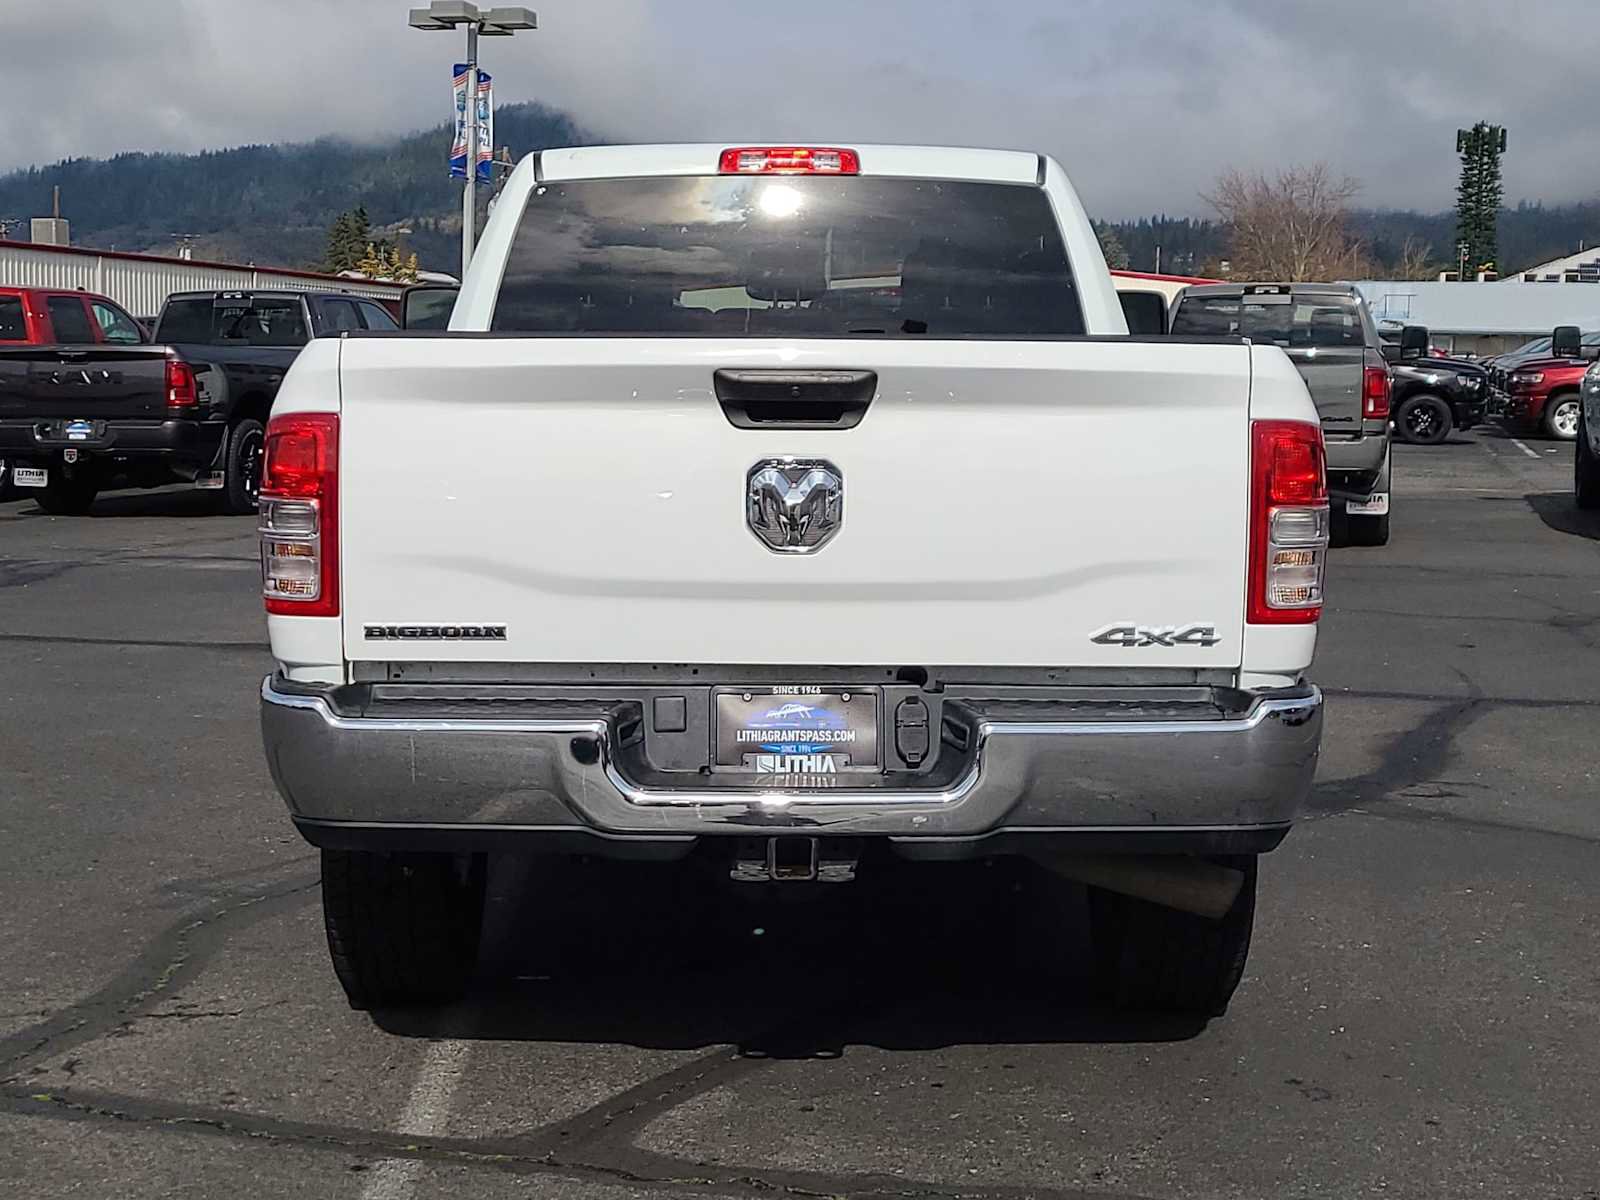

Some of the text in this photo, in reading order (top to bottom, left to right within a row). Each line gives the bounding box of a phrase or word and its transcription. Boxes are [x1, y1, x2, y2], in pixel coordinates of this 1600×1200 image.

[363, 626, 507, 641] BIGHORN
[1089, 627, 1222, 647] 4x4
[772, 686, 822, 695] SINCE 1946
[736, 730, 856, 742] LITHIAGRANTSPASS.COM
[775, 755, 836, 773] LITHIA
